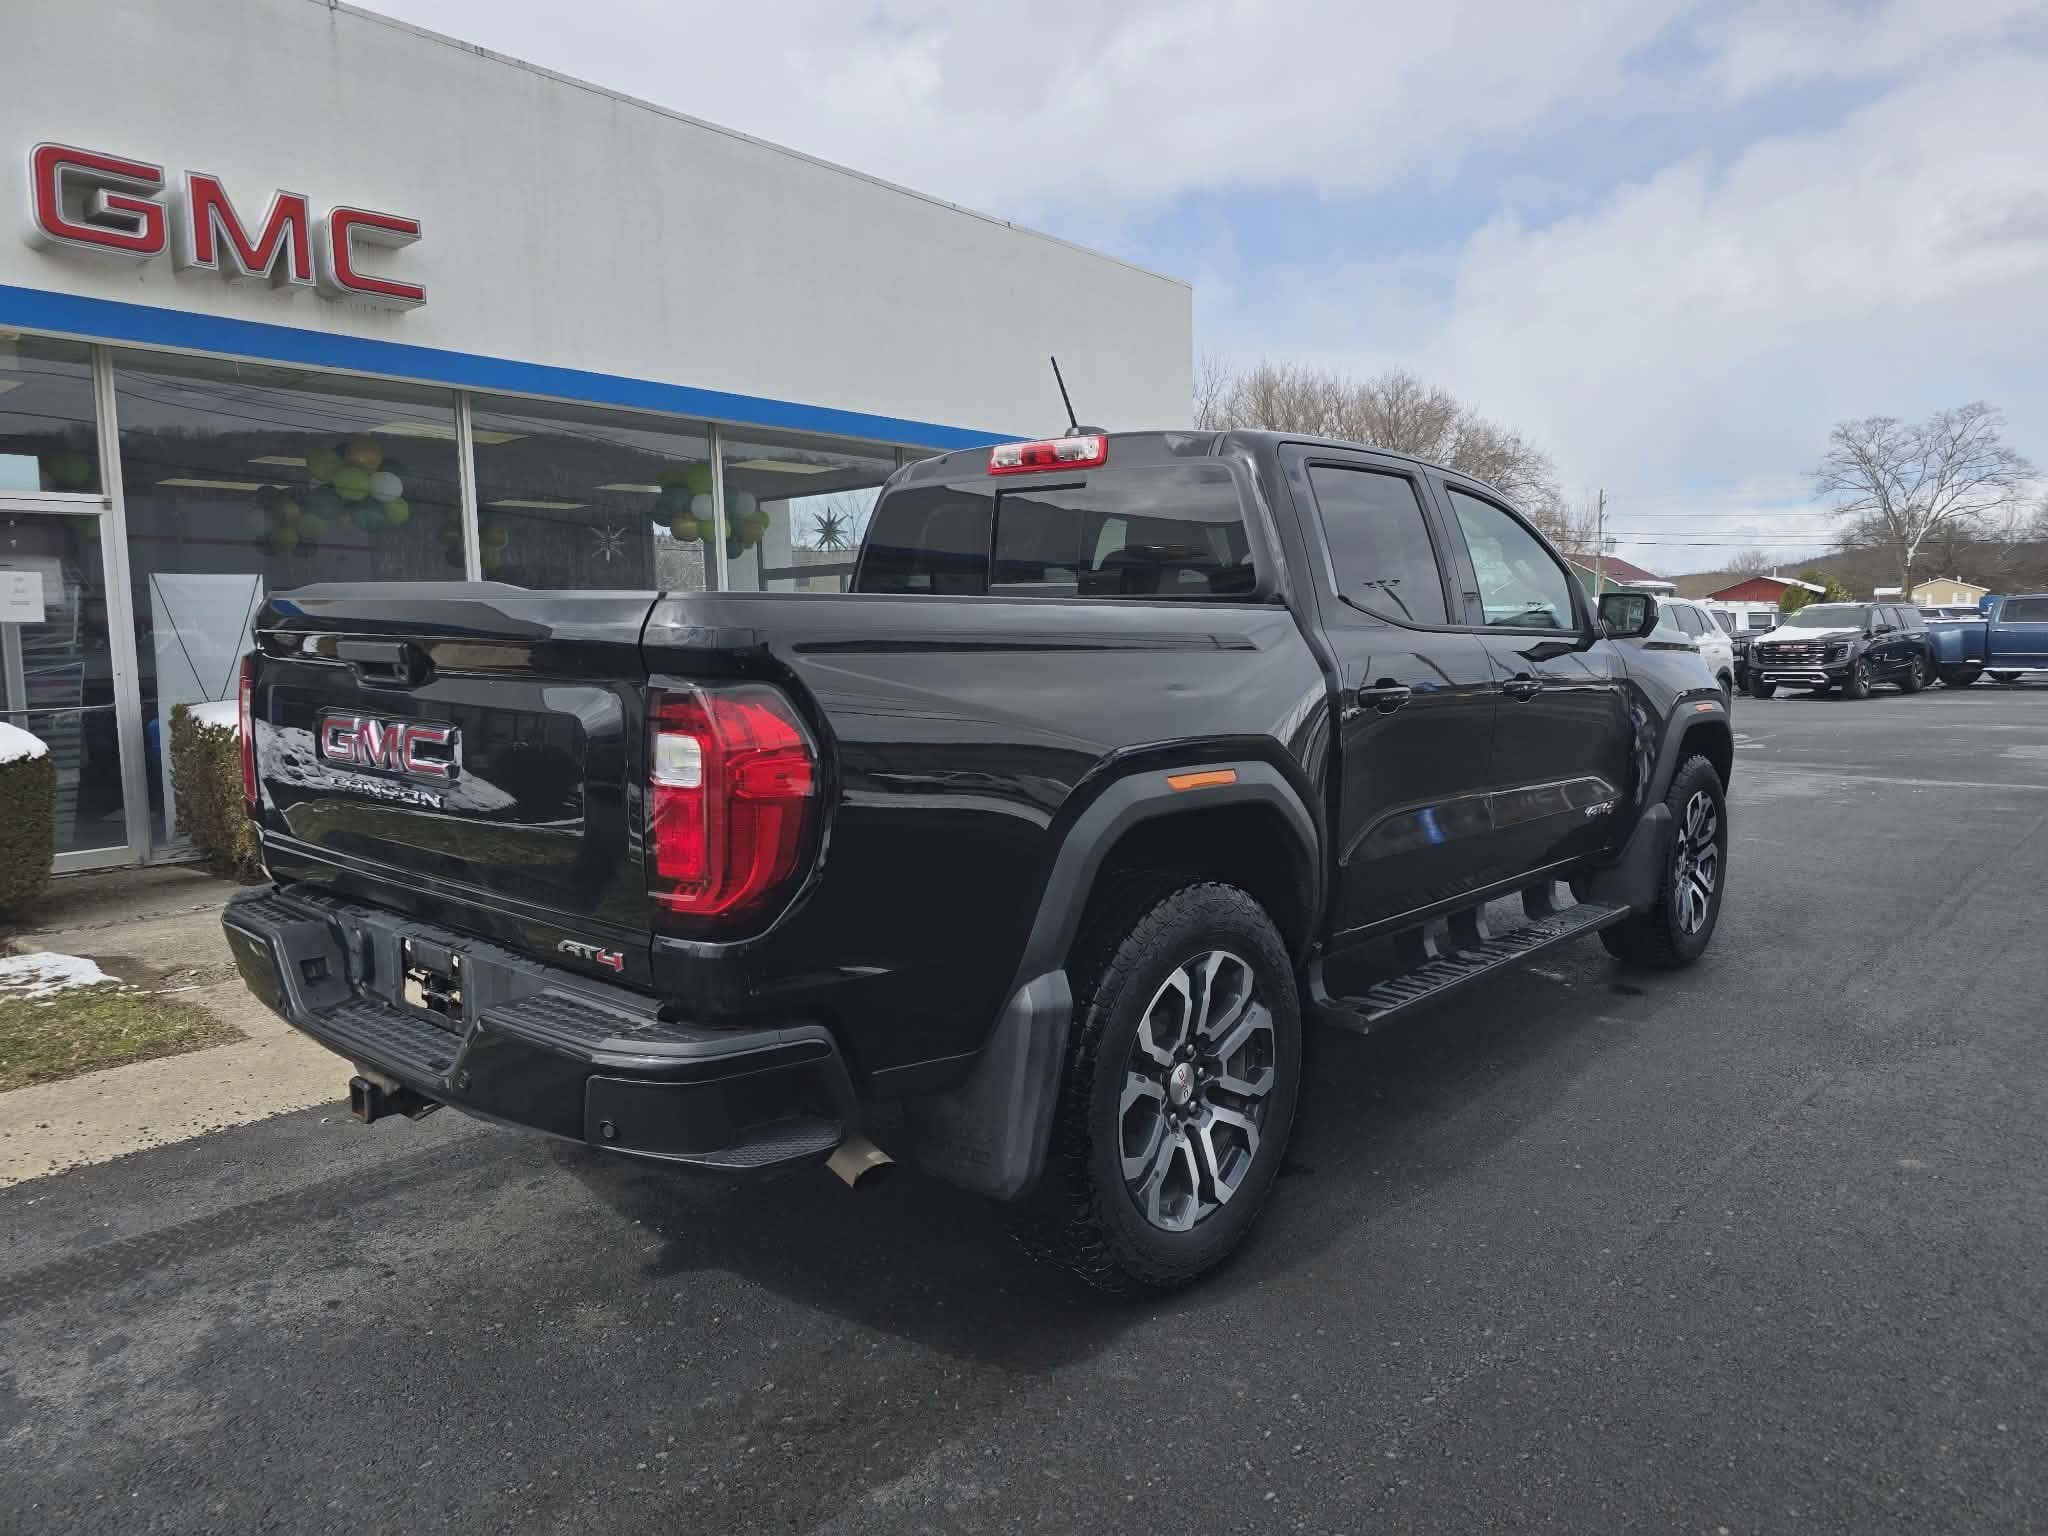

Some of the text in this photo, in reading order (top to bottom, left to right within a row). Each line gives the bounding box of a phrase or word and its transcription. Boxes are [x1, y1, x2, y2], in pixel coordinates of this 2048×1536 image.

[29, 141, 427, 307] GMC
[321, 716, 457, 778] GMC
[557, 939, 624, 973] AT4
